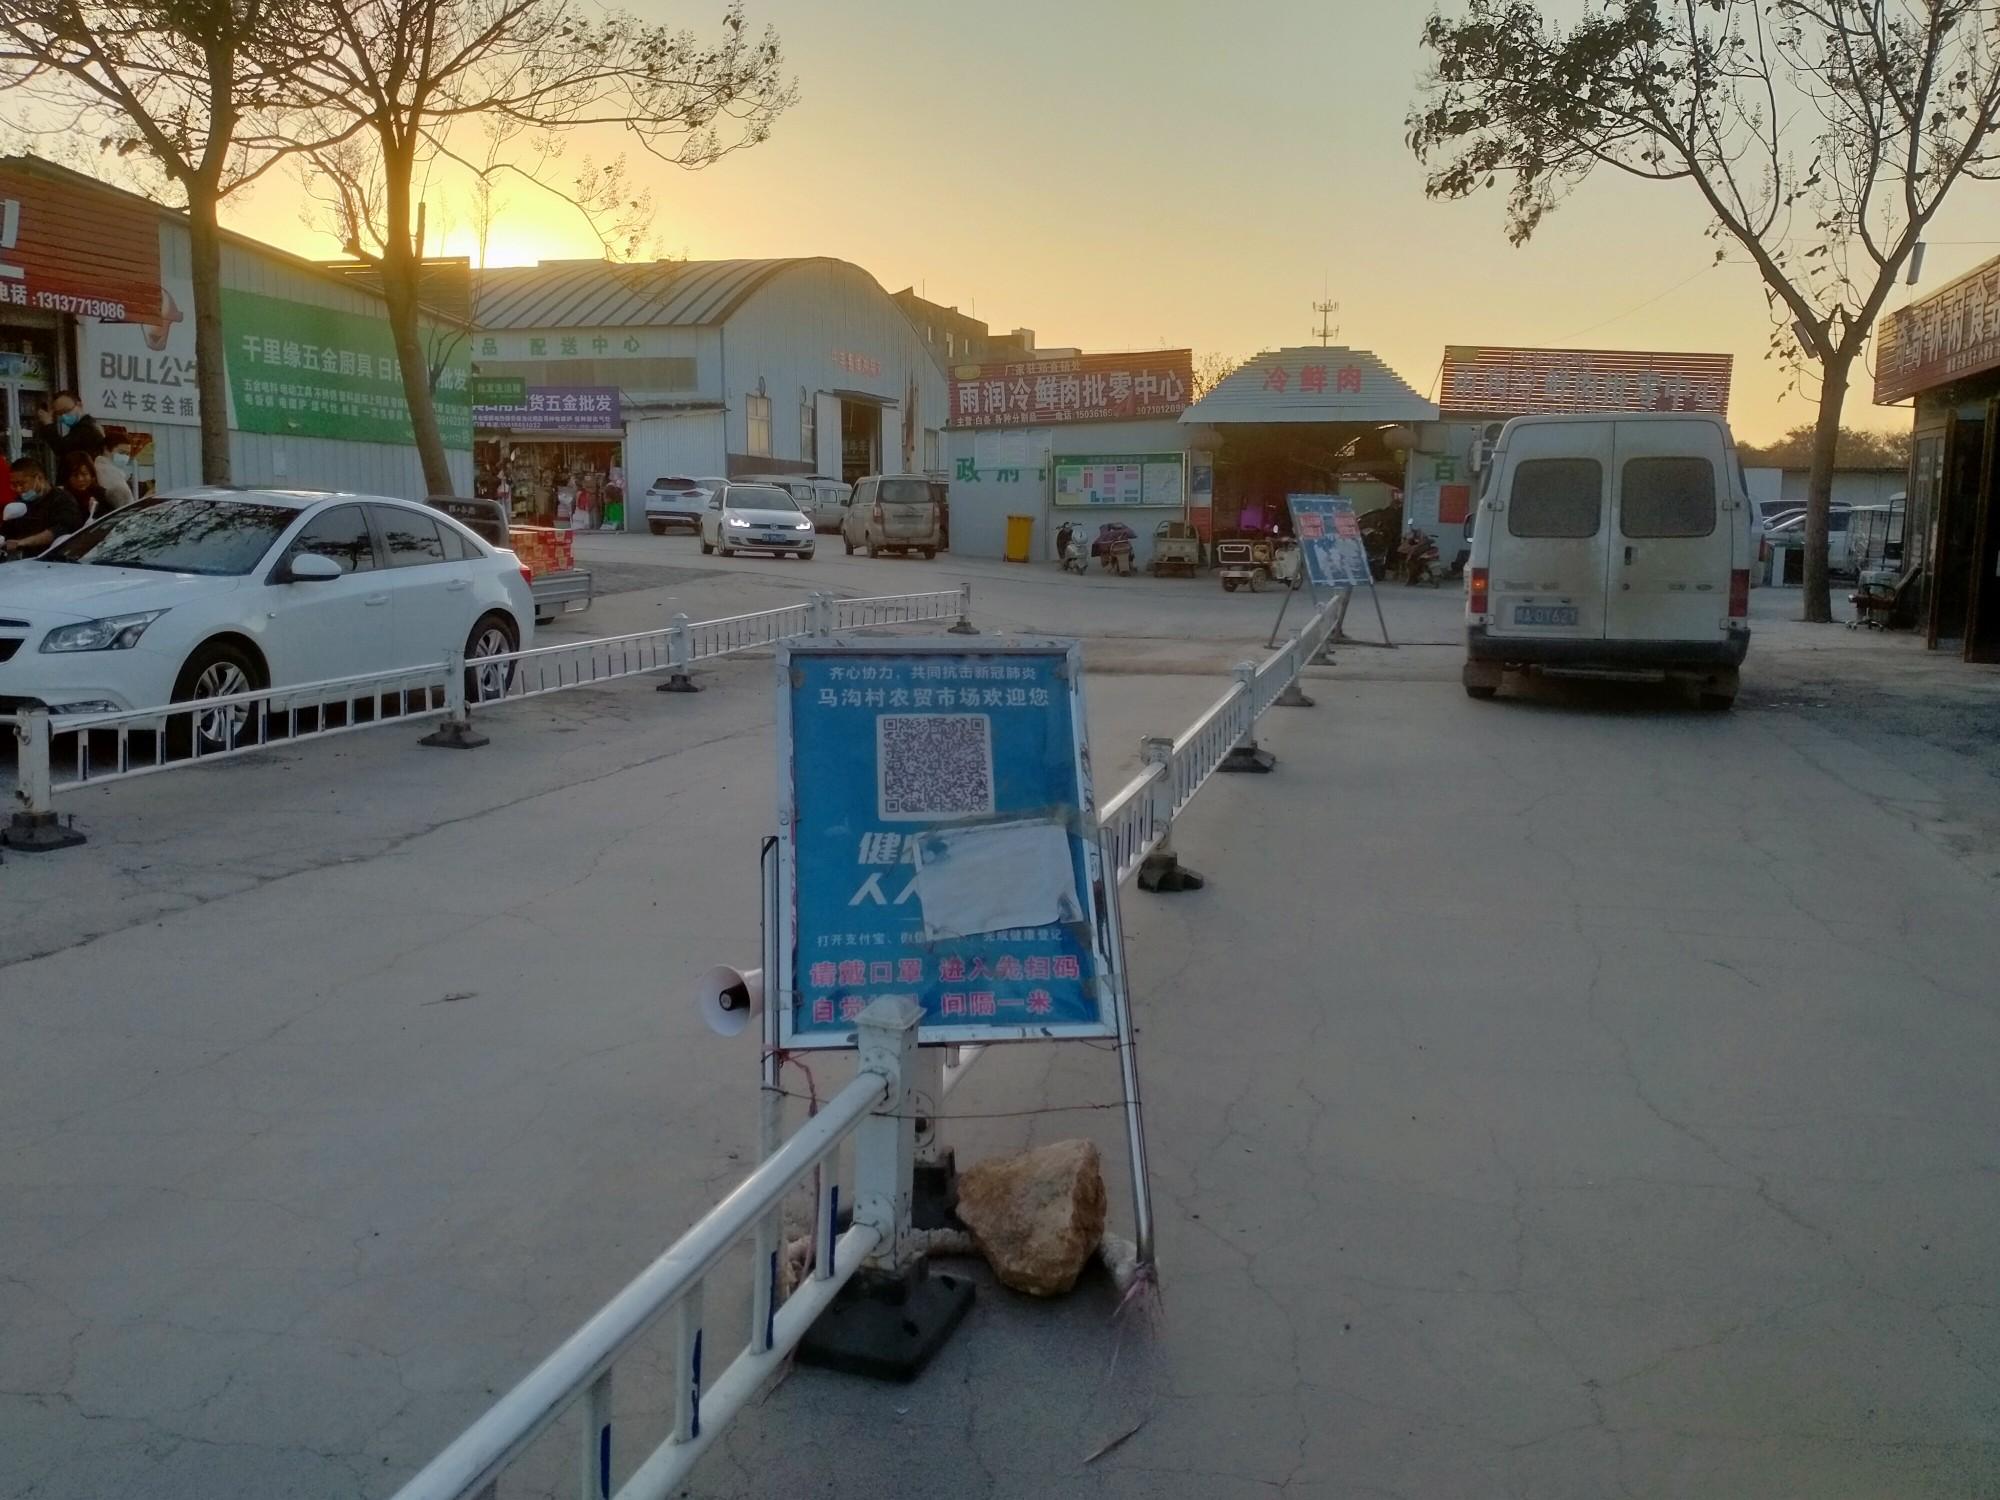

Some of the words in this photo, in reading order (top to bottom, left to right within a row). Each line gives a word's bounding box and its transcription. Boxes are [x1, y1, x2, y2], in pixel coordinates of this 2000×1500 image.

[529, 335, 640, 356] 配送中心
[957, 370, 1185, 414] 雨润冷鲜肉批零中心
[1264, 365, 1361, 393] 冷鲜肉
[817, 687, 1049, 708] 马沟村农贸市场欢迎您
[809, 957, 924, 988] 请戴口罩
[938, 953, 1081, 983] 进入先扫码
[940, 990, 1053, 1018] 间隔一米
